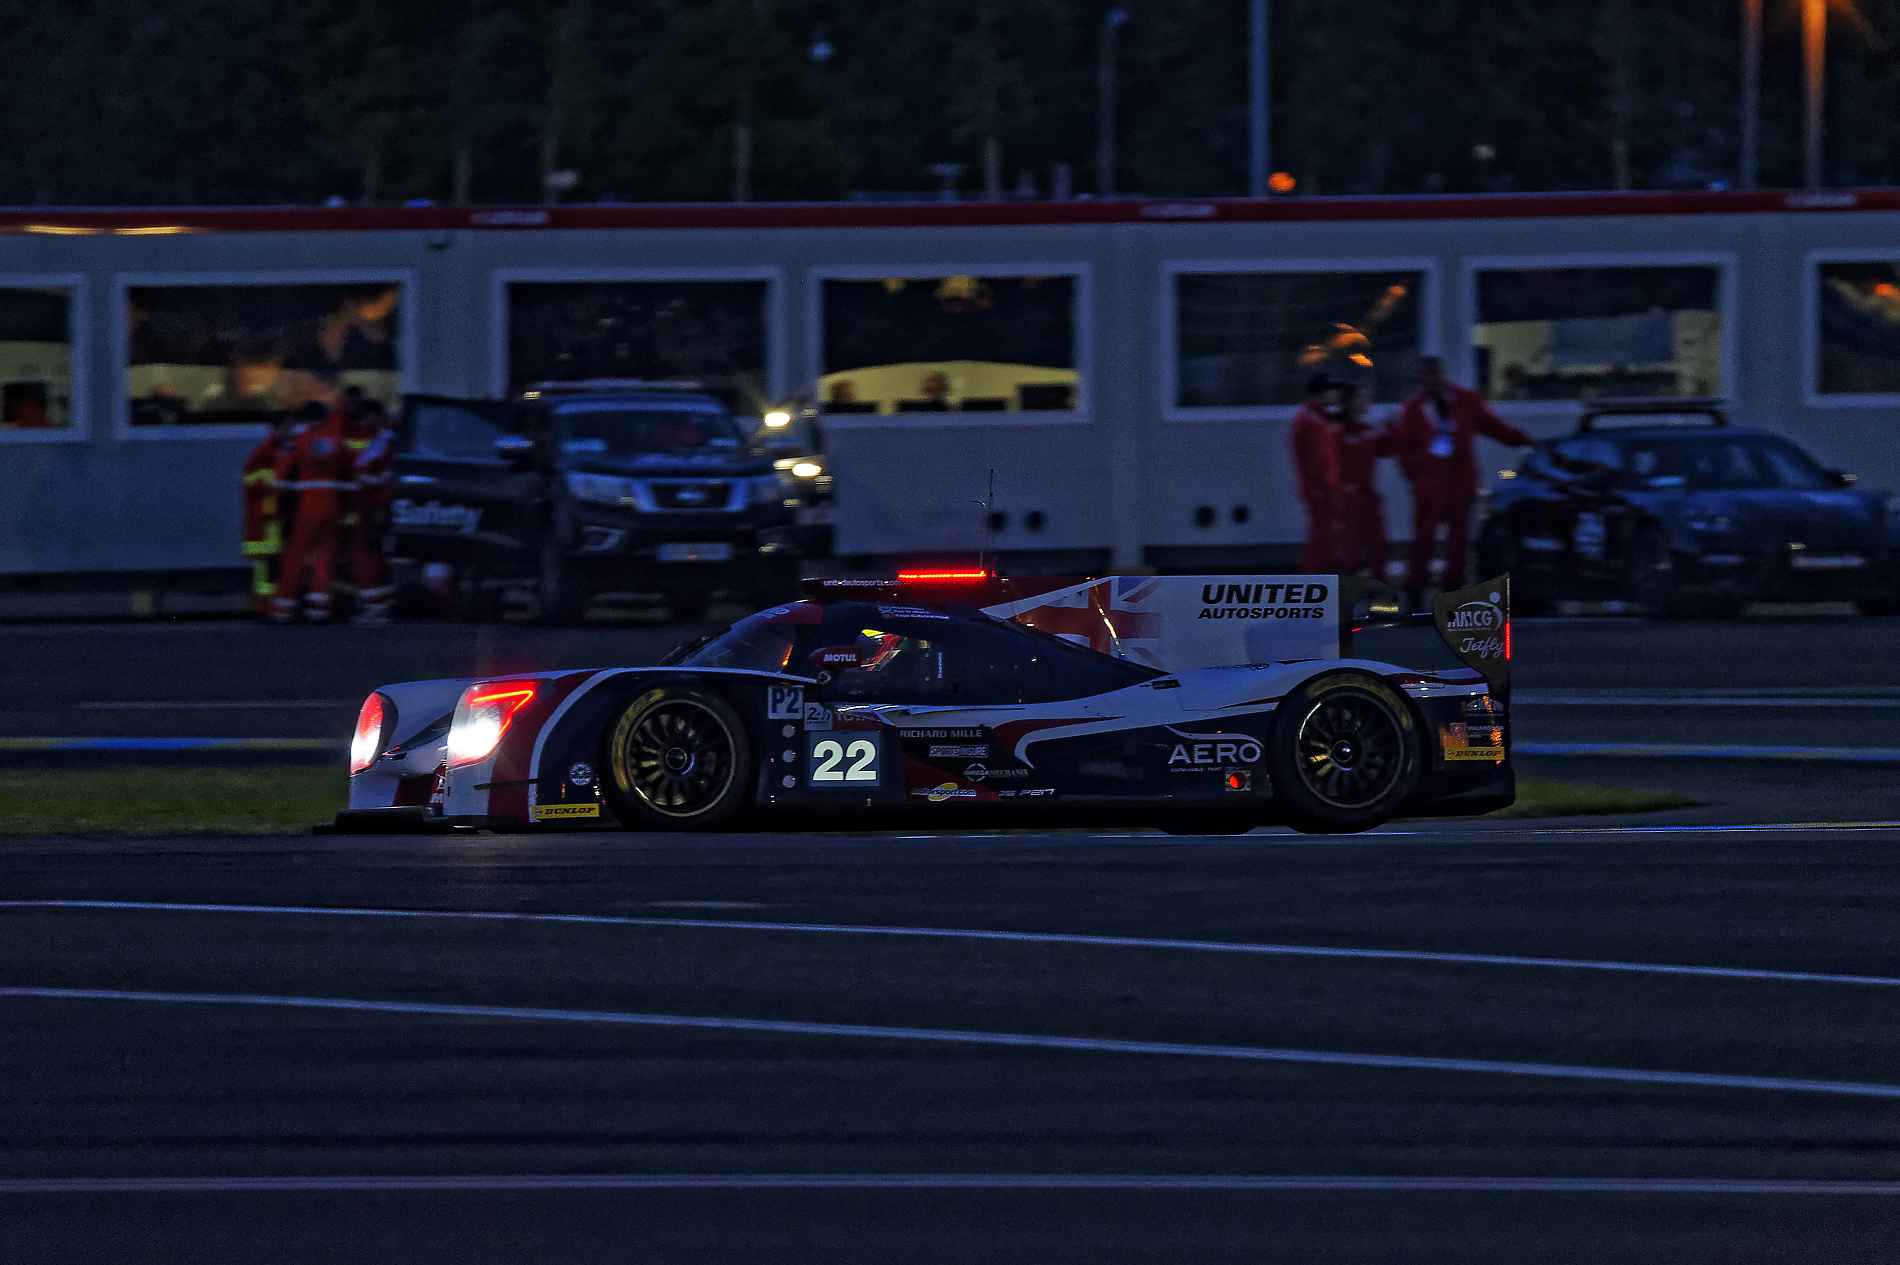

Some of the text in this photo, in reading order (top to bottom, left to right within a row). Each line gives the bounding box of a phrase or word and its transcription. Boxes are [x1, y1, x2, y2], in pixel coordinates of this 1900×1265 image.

[1202, 584, 1328, 604] UNITED
[1198, 607, 1324, 619] AUTOSPORTS
[823, 653, 857, 663] MOTUL
[771, 688, 802, 714] P2
[900, 729, 983, 738] RICHARD MILLE
[812, 739, 877, 781] 22
[1168, 742, 1262, 764] AERO
[545, 806, 596, 815] DUNLOP
